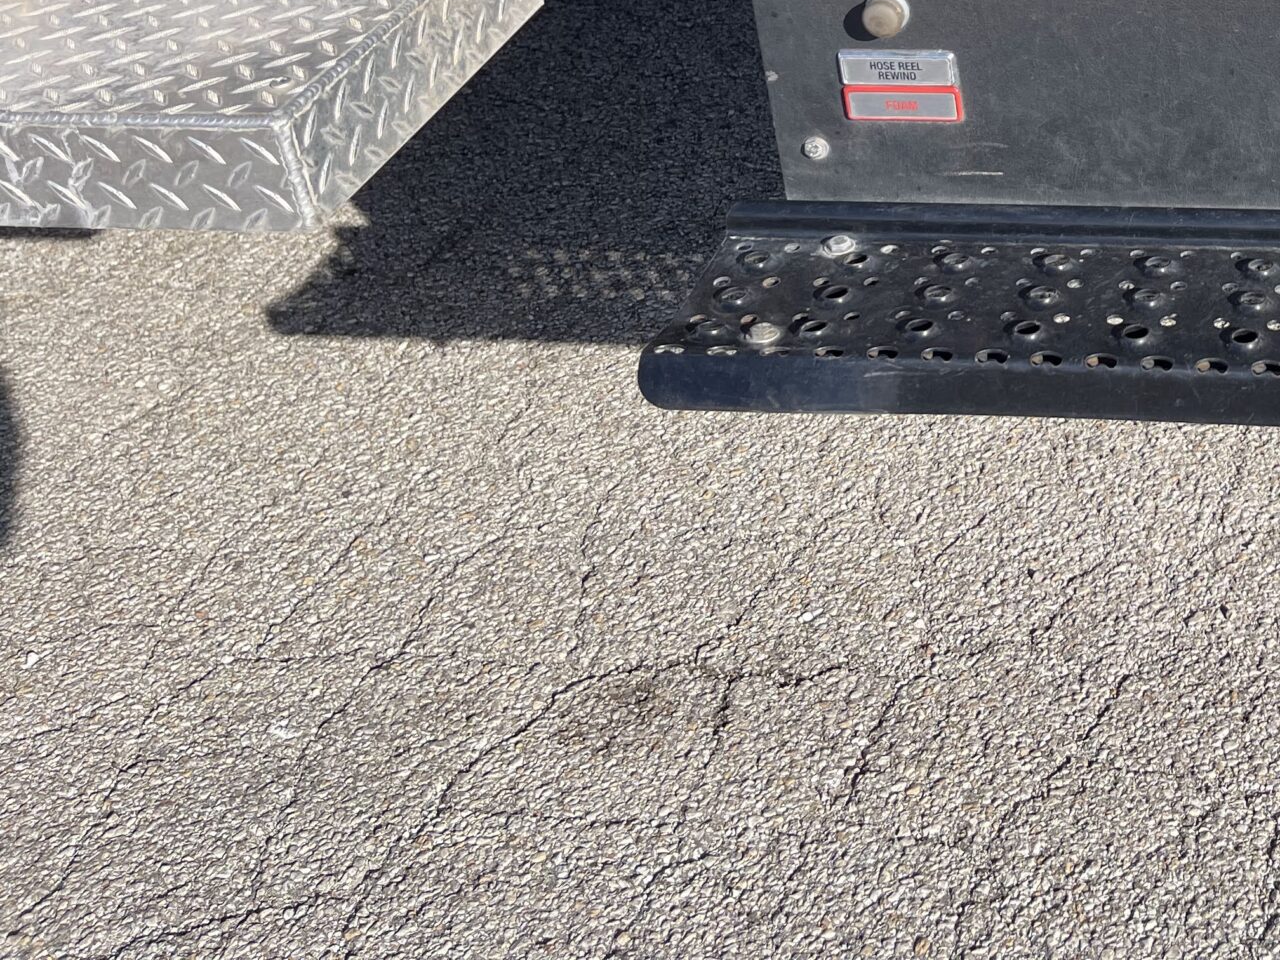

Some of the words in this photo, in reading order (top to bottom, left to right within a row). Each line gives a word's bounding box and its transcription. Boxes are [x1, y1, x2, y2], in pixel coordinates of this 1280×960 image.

[869, 61, 896, 71] HOSE
[898, 61, 923, 71] REEL
[878, 71, 917, 81] REWIND
